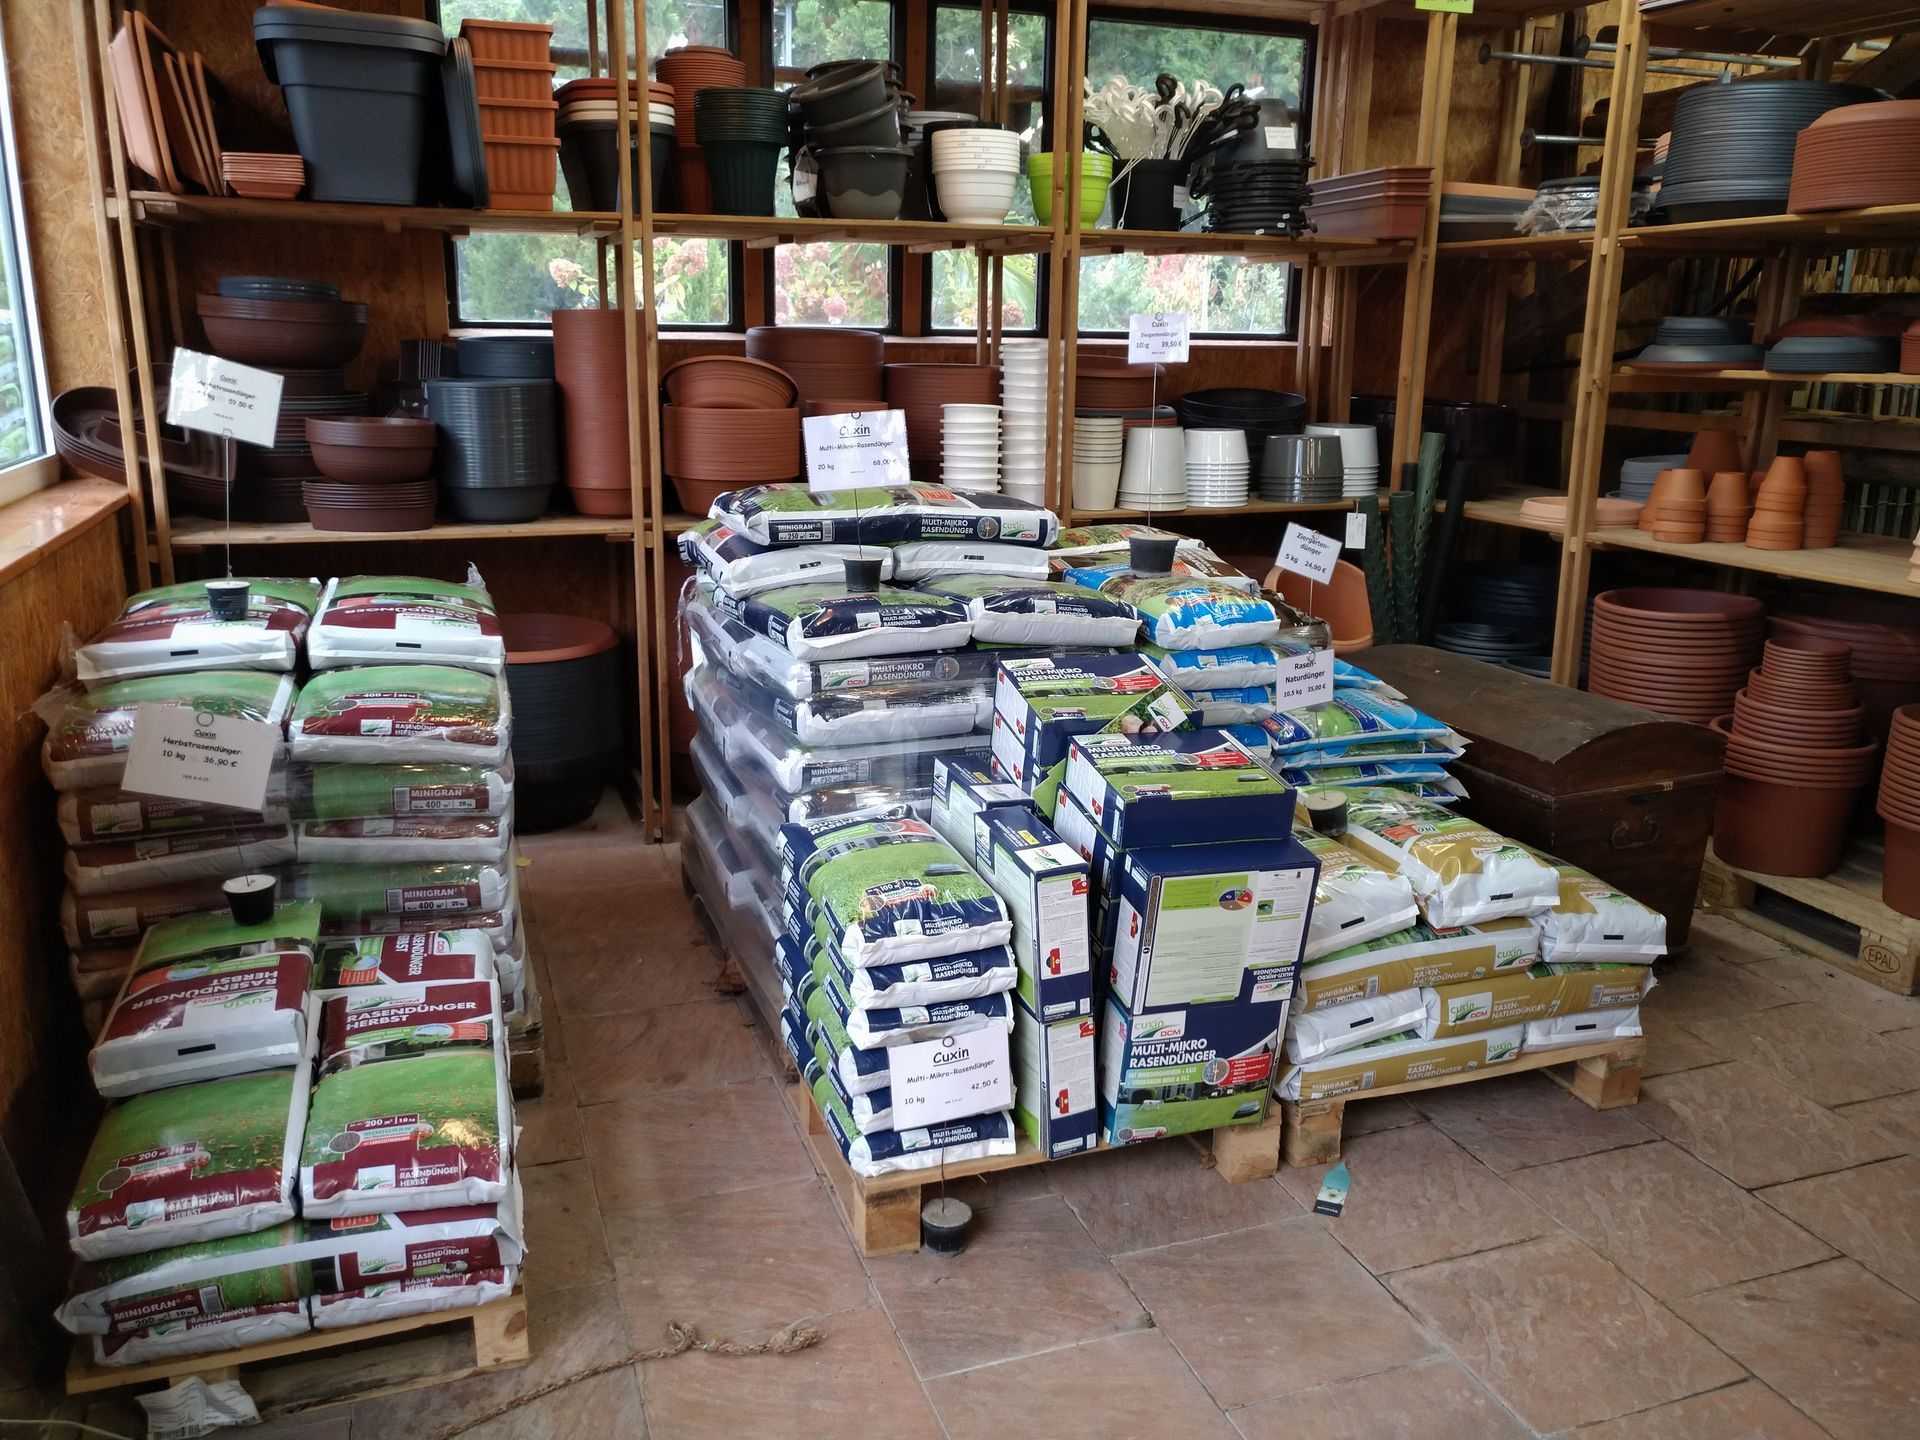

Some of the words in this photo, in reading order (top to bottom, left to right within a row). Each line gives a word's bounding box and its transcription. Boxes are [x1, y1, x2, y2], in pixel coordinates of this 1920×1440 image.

[839, 424, 871, 436] Cuxin
[819, 441, 894, 452] Multi-Mikro-Rasendünger
[921, 518, 968, 527] MULTI-MIKRO
[921, 525, 974, 535] RASENDÜNGER
[1297, 532, 1330, 549] Ziergarten-
[1300, 543, 1322, 556] dünger
[1290, 554, 1299, 564] kg
[1305, 560, 1321, 572] 24,90
[883, 620, 921, 628] RASENDÜNGER
[871, 662, 925, 674] MULTI-MIKRO
[1294, 660, 1316, 670] Rasen-
[871, 669, 931, 682] RASENDÜNGER
[1013, 667, 1083, 677] MULTI-MIKRO
[1285, 670, 1325, 684] Naturdünger
[1283, 688, 1295, 698] 10,5
[1295, 688, 1302, 697] kg
[1307, 684, 1321, 693] 35,00
[1159, 718, 1171, 731] DCM
[194, 728, 217, 740] Cuxin
[163, 736, 243, 755] Herbstrasendünger
[1088, 744, 1161, 754] MULTI-MIKRO
[162, 749, 174, 759] 10
[176, 752, 187, 762] kg
[203, 755, 229, 767] 36,90
[411, 789, 462, 797] MINIGRAN
[425, 801, 441, 809] 400
[404, 888, 456, 899] MINIGRAN
[418, 901, 434, 910] 400
[925, 918, 963, 929] MULTI-MIKRO
[396, 935, 410, 952] ERBST
[409, 933, 427, 977] SENDÜNGER
[1496, 948, 1522, 959] cuxin
[1868, 948, 1894, 970] EPAL
[934, 961, 973, 974] MULTI-MIKRO
[935, 967, 979, 979] RASENDÜNGER
[210, 970, 279, 986] HERBST
[1257, 971, 1295, 982] MULTI-MIKRO
[131, 977, 278, 1010] RASENDÜNGER
[1317, 986, 1354, 999] MINIGRAN
[223, 996, 274, 1009] cuxin
[1451, 1002, 1475, 1014] cuxin
[1493, 1002, 1519, 1012] RASEN-
[347, 1001, 477, 1023] RASENDÜNGER
[931, 1005, 969, 1016] MULTI-MIKRO
[1470, 1011, 1488, 1019] DCM
[1491, 1004, 1546, 1019] NATURDÜNGER
[346, 1014, 410, 1031] HERBST
[1134, 1018, 1165, 1030] cuxin
[1160, 1028, 1181, 1037] DCM
[1131, 1038, 1208, 1056] MULTI-MIKRO
[1488, 1042, 1513, 1053] cuxin
[933, 1048, 970, 1065] Cuxin
[1129, 1049, 1217, 1068] RASENDÜNGER
[907, 1059, 995, 1083] Multi-Mikro-Rasendünger
[1405, 1066, 1462, 1081] NATURDÜNGER
[1408, 1064, 1434, 1075] RASEN-
[971, 1080, 991, 1091] 42,50
[916, 1096, 925, 1104] kg
[365, 1118, 383, 1127] 200
[932, 1126, 972, 1139] MULTI-MIKRO
[138, 1150, 158, 1161] 200
[400, 1164, 460, 1179] RASENDÜNGER
[400, 1178, 429, 1187] HERBST
[170, 1208, 201, 1220] HERBST
[412, 1247, 470, 1261] RASENDÜNGER
[360, 1256, 387, 1267] cuxin
[384, 1263, 404, 1271] DCM
[412, 1257, 441, 1267] HERBST
[114, 1300, 177, 1320] MINIGRAN
[135, 1317, 155, 1329] 200
[176, 1309, 186, 1317] 10
